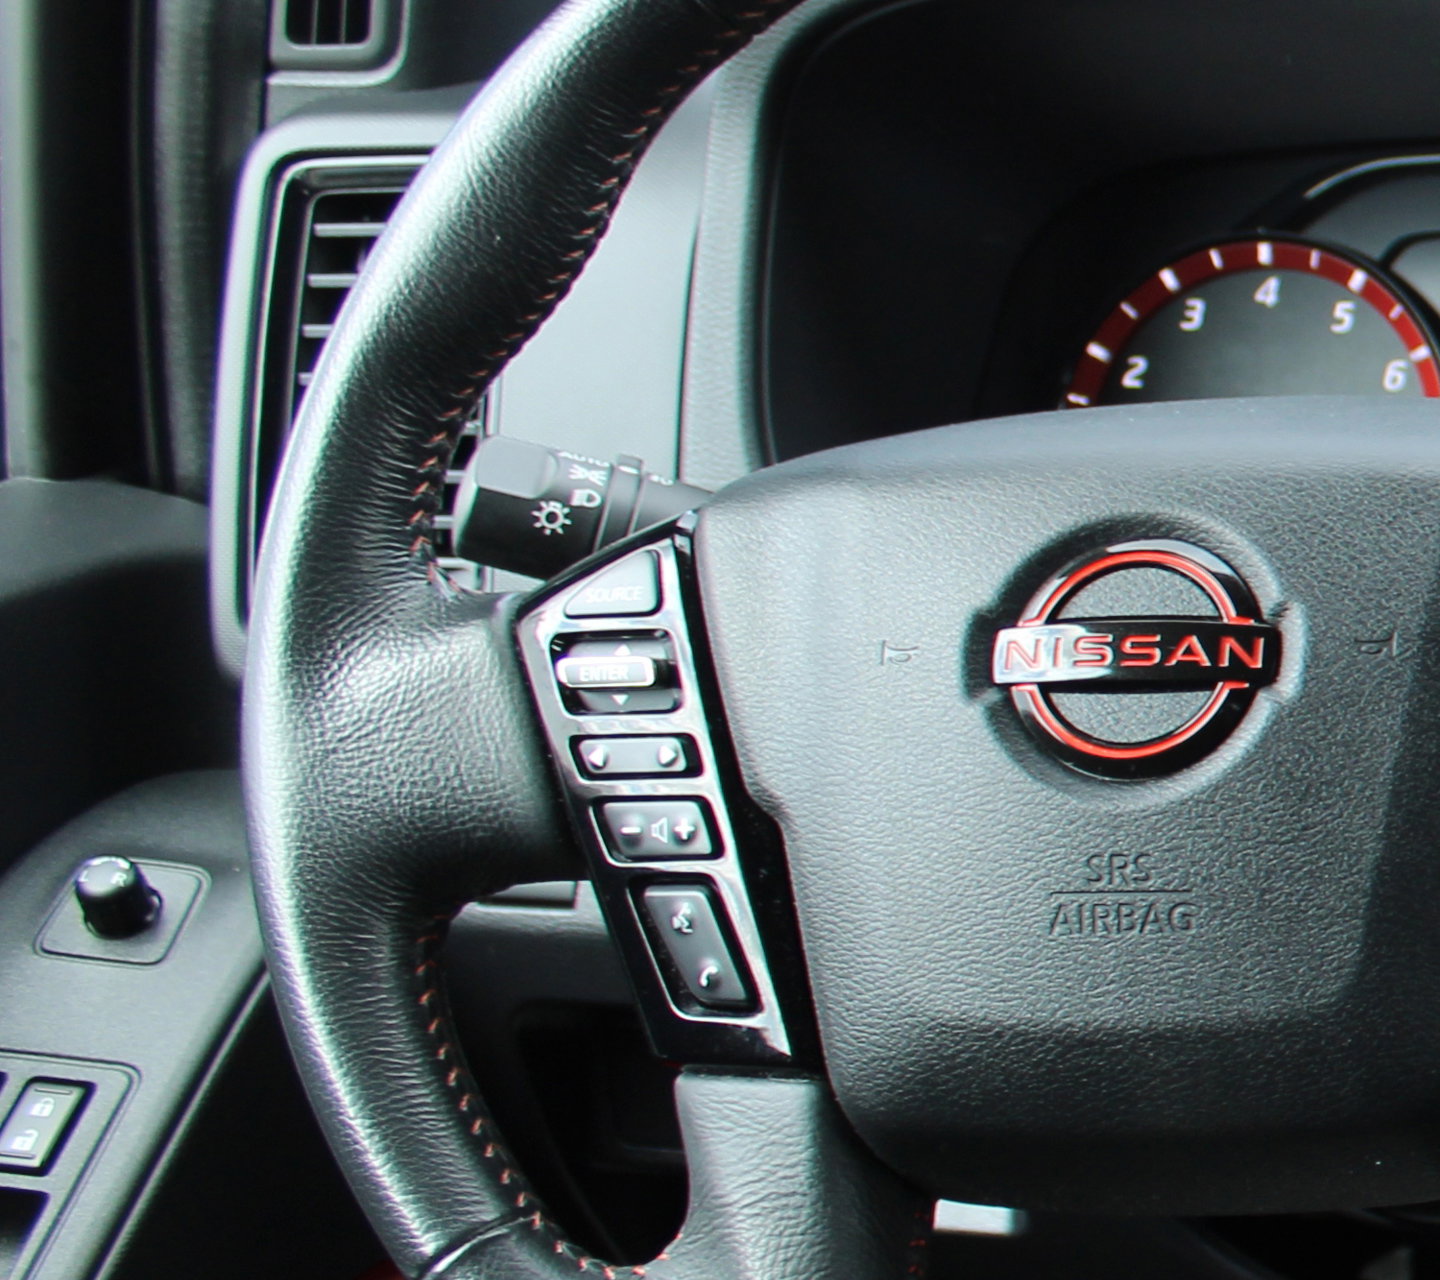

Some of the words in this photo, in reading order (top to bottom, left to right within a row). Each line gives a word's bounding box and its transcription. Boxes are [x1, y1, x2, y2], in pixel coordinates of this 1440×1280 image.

[1254, 276, 1282, 308] 4
[1179, 298, 1206, 332] 3
[1329, 300, 1357, 334] 5
[1121, 355, 1149, 389] 2
[1382, 359, 1408, 392] 6
[586, 586, 644, 603] SOURCE
[1004, 634, 1265, 669] NISSAN
[578, 667, 631, 681] ENTER
[1086, 853, 1153, 885] SRS
[1050, 901, 1200, 935] AIRBAG
